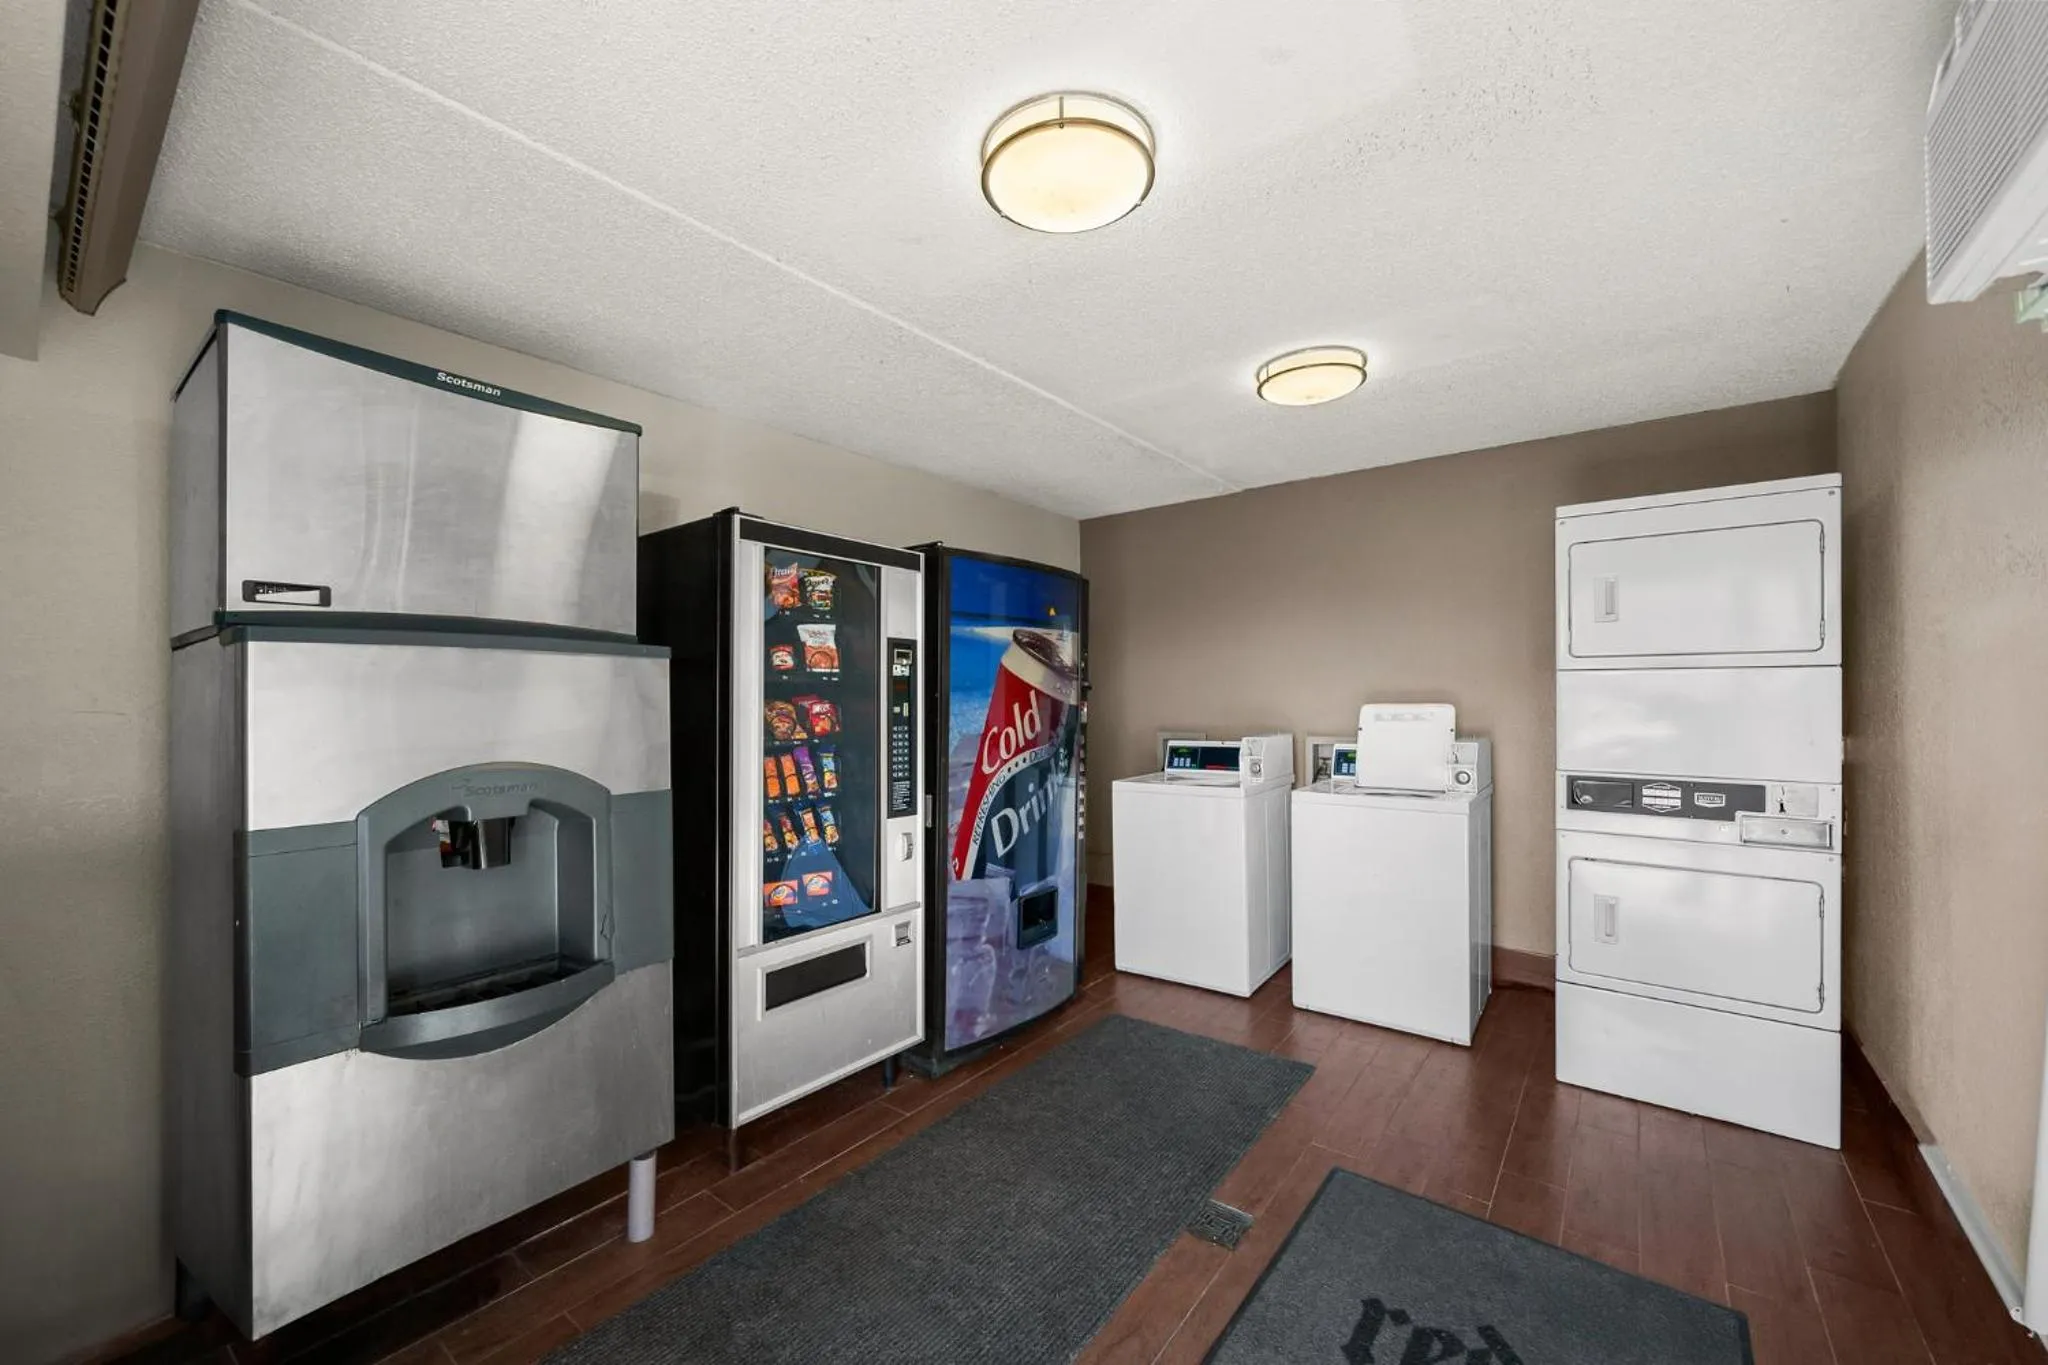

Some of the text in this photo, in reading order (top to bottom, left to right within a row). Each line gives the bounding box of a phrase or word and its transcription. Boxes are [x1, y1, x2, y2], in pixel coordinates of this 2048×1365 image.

[436, 371, 501, 397] Scotsman
[981, 689, 1042, 775] Cold
[463, 781, 539, 797] Scotsman
[972, 768, 1006, 846] REFRESHING
